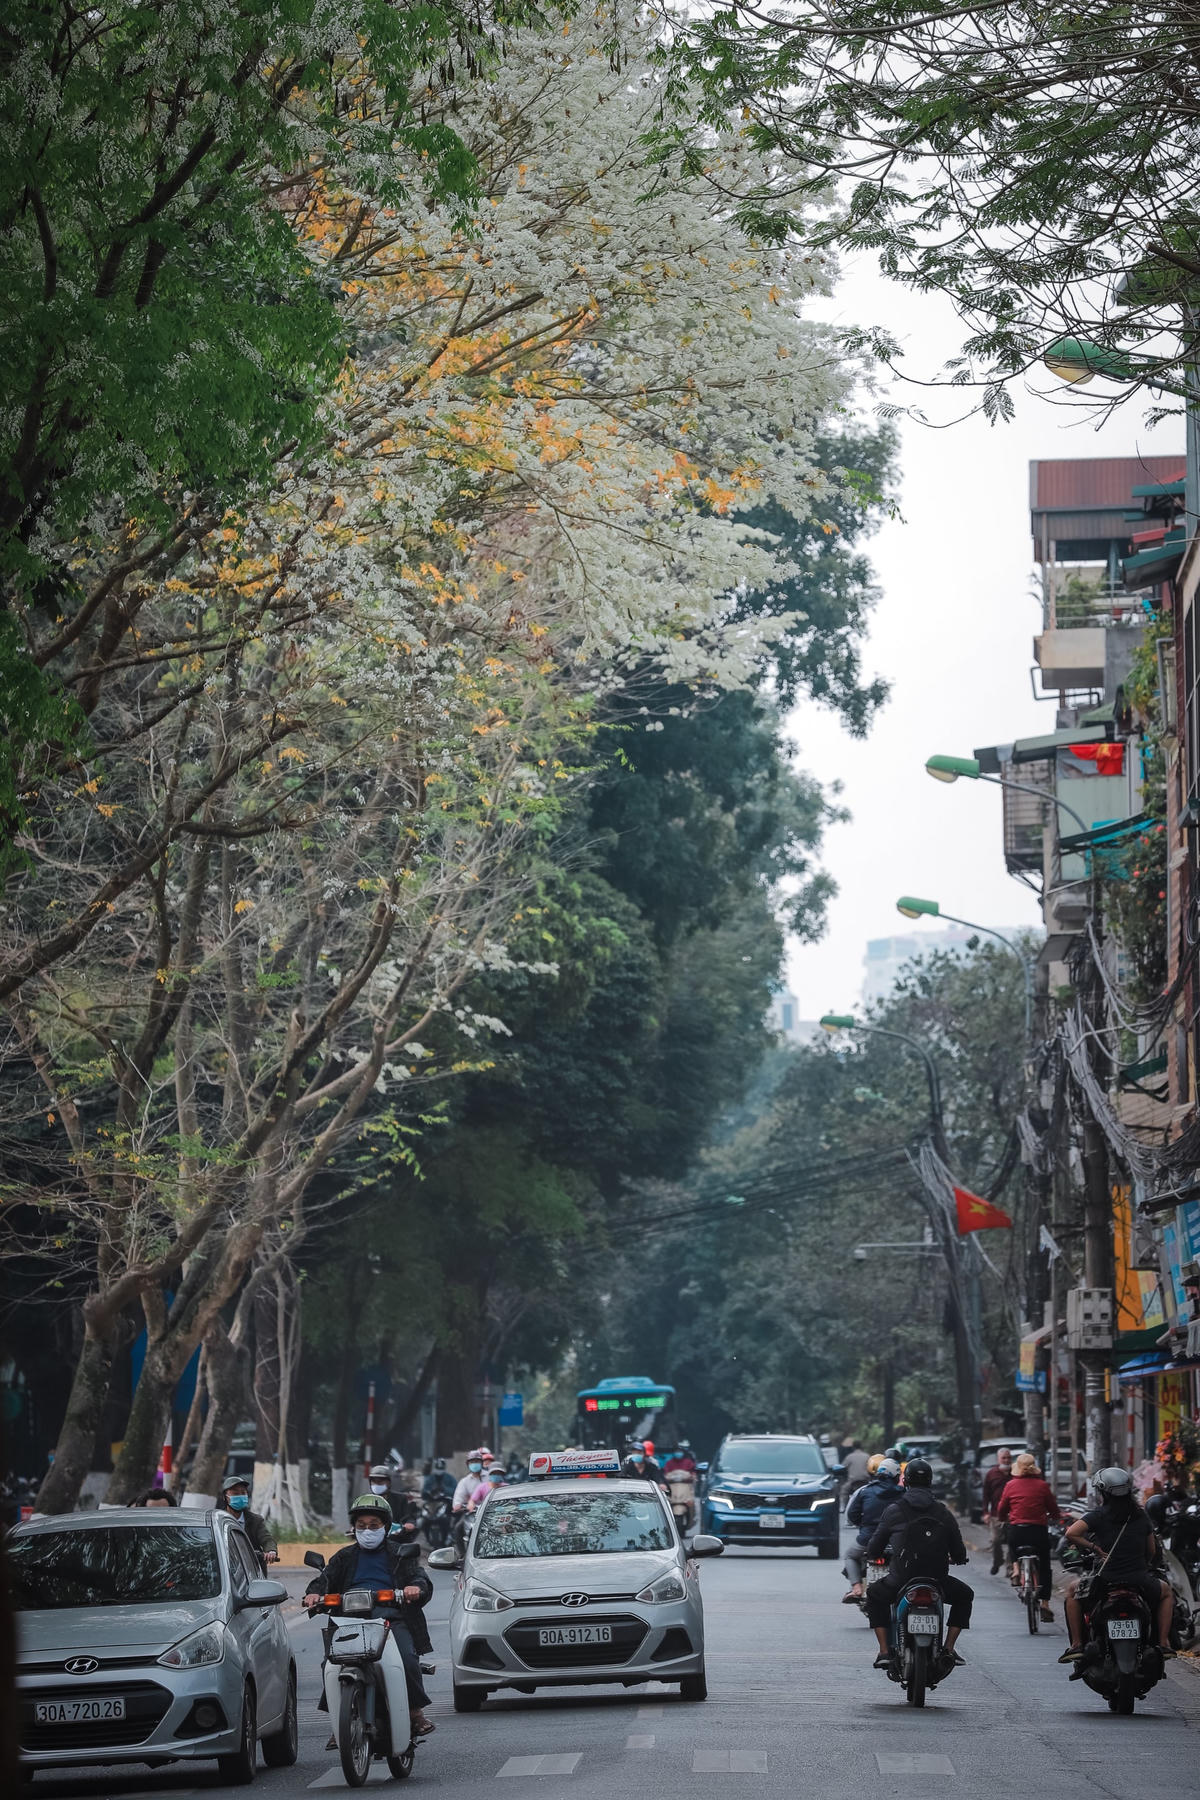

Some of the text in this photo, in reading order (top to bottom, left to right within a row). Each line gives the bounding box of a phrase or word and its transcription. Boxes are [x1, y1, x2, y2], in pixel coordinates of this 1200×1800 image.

[540, 1627, 610, 1644] 30A-912.16
[1111, 1629, 1138, 1638] 878.23
[38, 1700, 122, 1721] 30A-720.26
